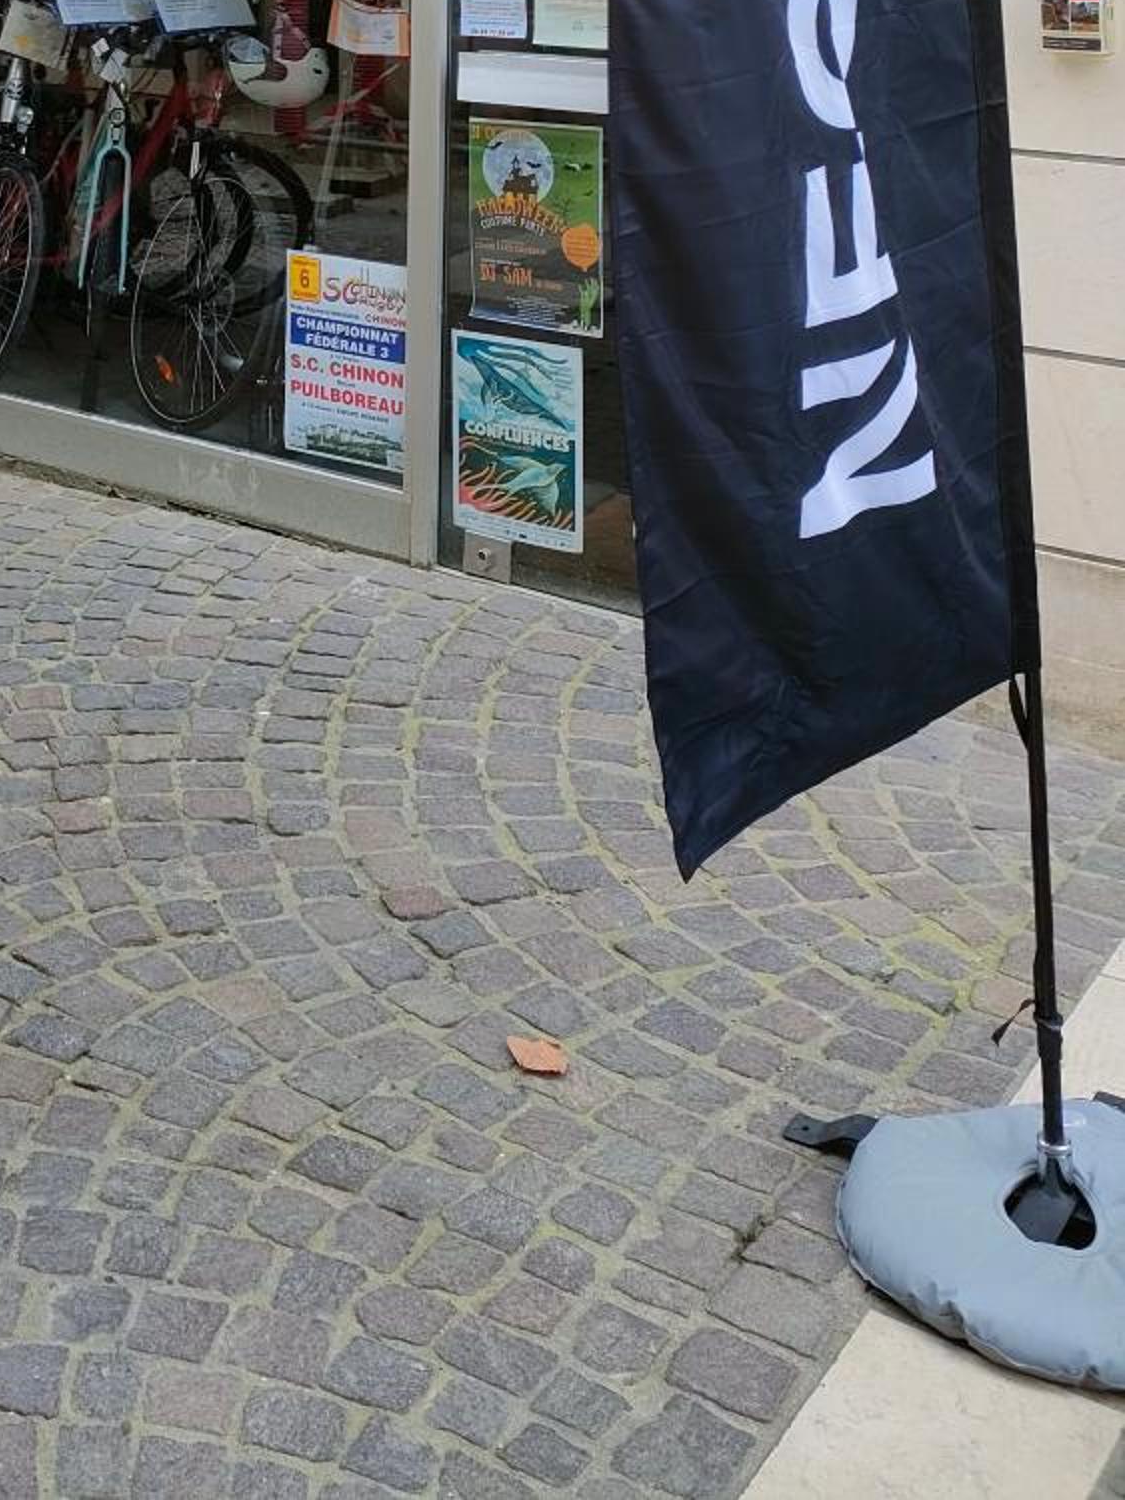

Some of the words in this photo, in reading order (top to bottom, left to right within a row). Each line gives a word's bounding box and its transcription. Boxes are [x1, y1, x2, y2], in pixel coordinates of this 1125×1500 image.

[299, 269, 310, 288] 6
[296, 317, 400, 345] CHAMPIONNAT
[305, 332, 376, 357] FÉDÉRALE
[379, 346, 390, 359] 3
[290, 353, 324, 374] S.C.
[330, 361, 404, 389] CHINON
[290, 379, 404, 415] PUILBOREAU
[464, 419, 571, 452] CONFLUENCES
